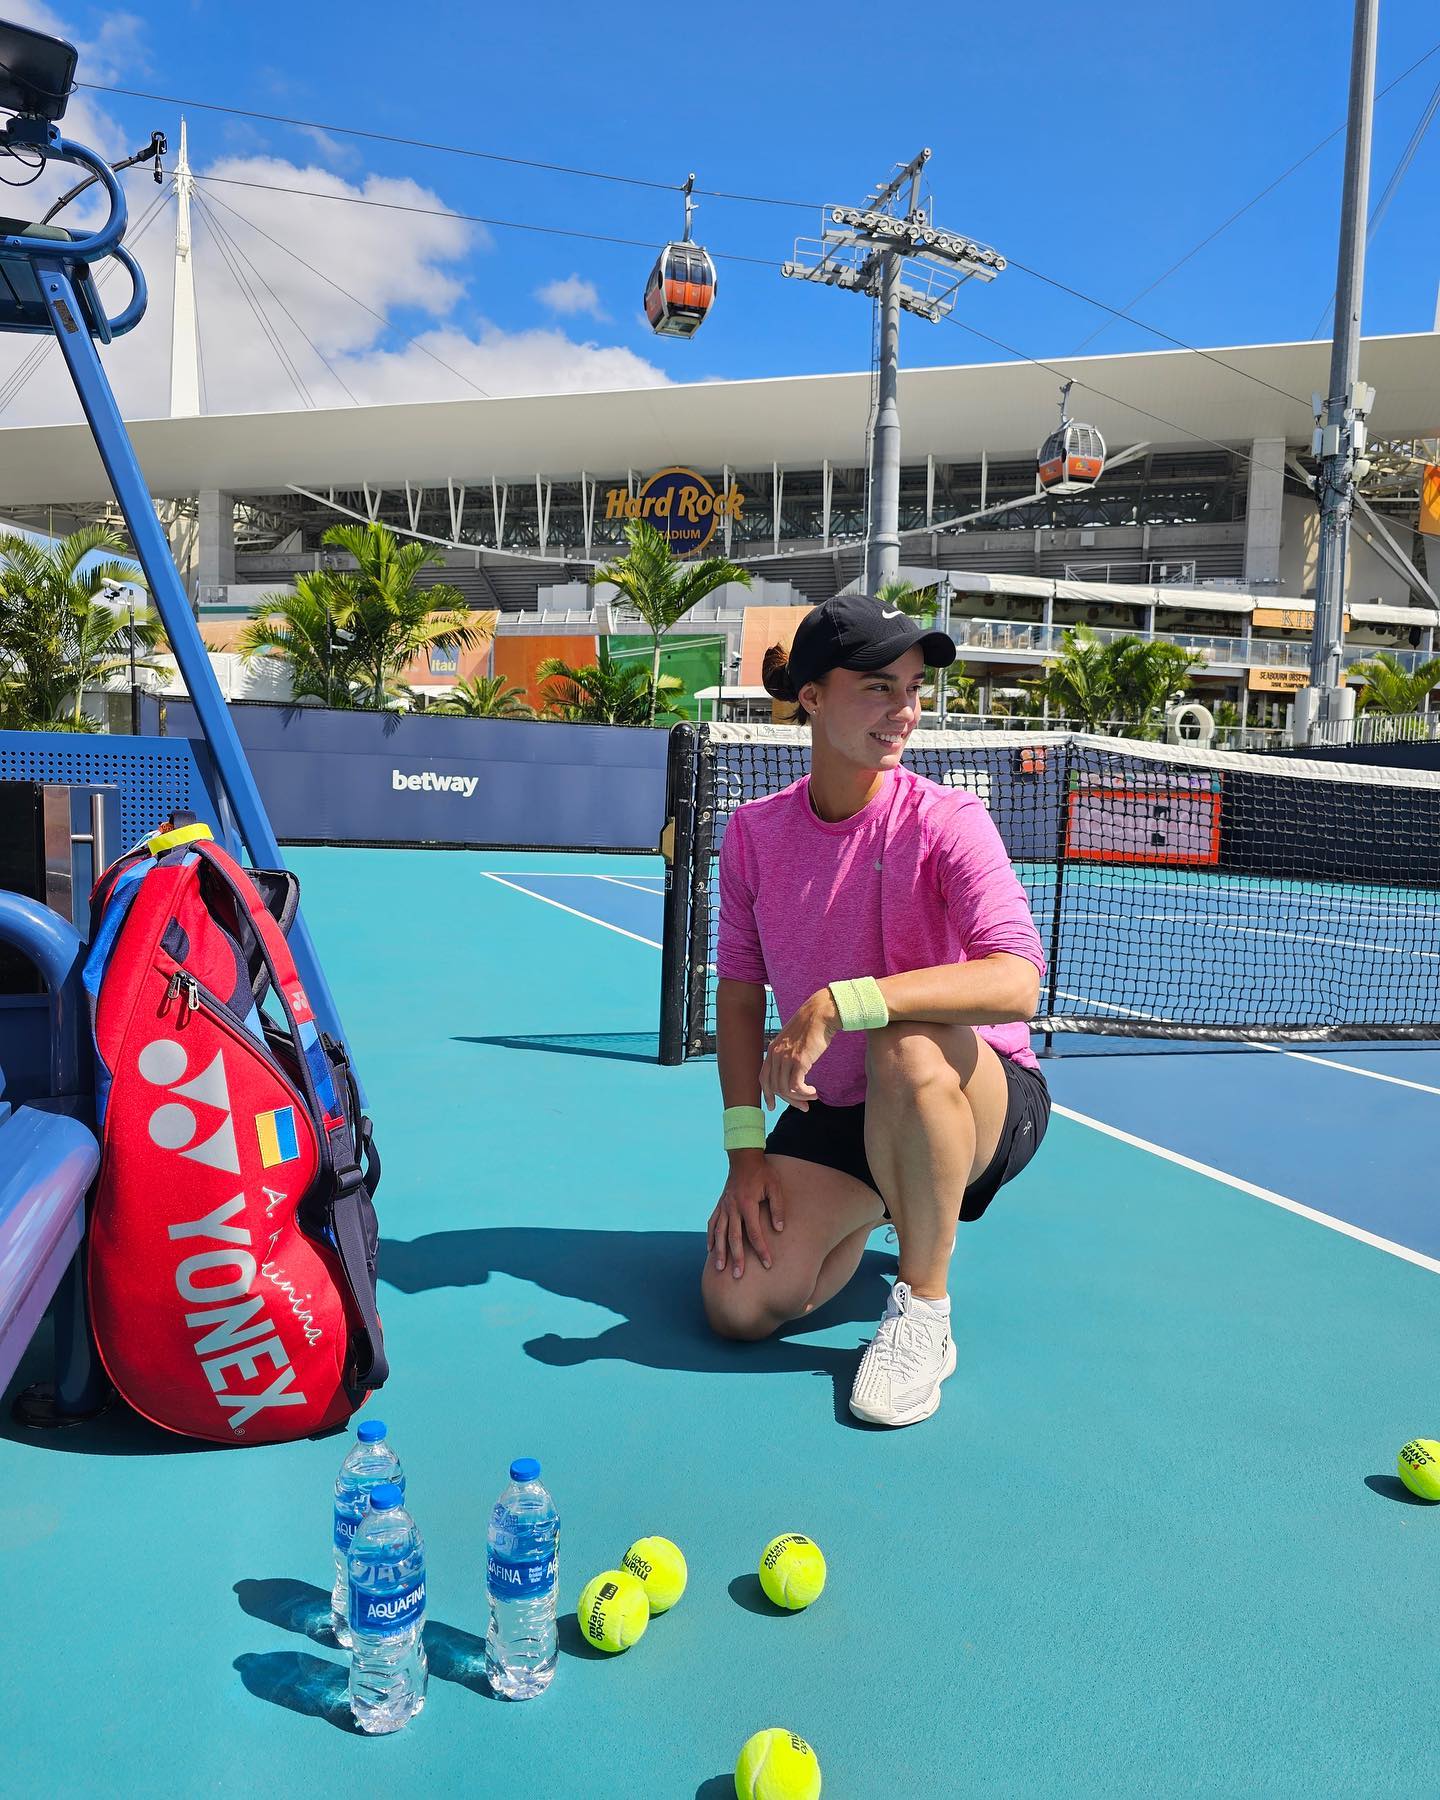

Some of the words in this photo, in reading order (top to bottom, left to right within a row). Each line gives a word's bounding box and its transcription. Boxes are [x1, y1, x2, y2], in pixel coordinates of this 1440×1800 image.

[605, 486, 675, 519] Hard
[678, 483, 745, 523] Rock
[656, 529, 701, 540] TADIUM
[392, 769, 479, 797] betway
[167, 1192, 308, 1430] YONEX
[631, 1552, 653, 1573] open
[764, 1535, 793, 1567] miami
[767, 1546, 787, 1570] open
[367, 1582, 426, 1619] AQUAFINA
[587, 1596, 604, 1639] miami
[596, 1612, 607, 1642] open
